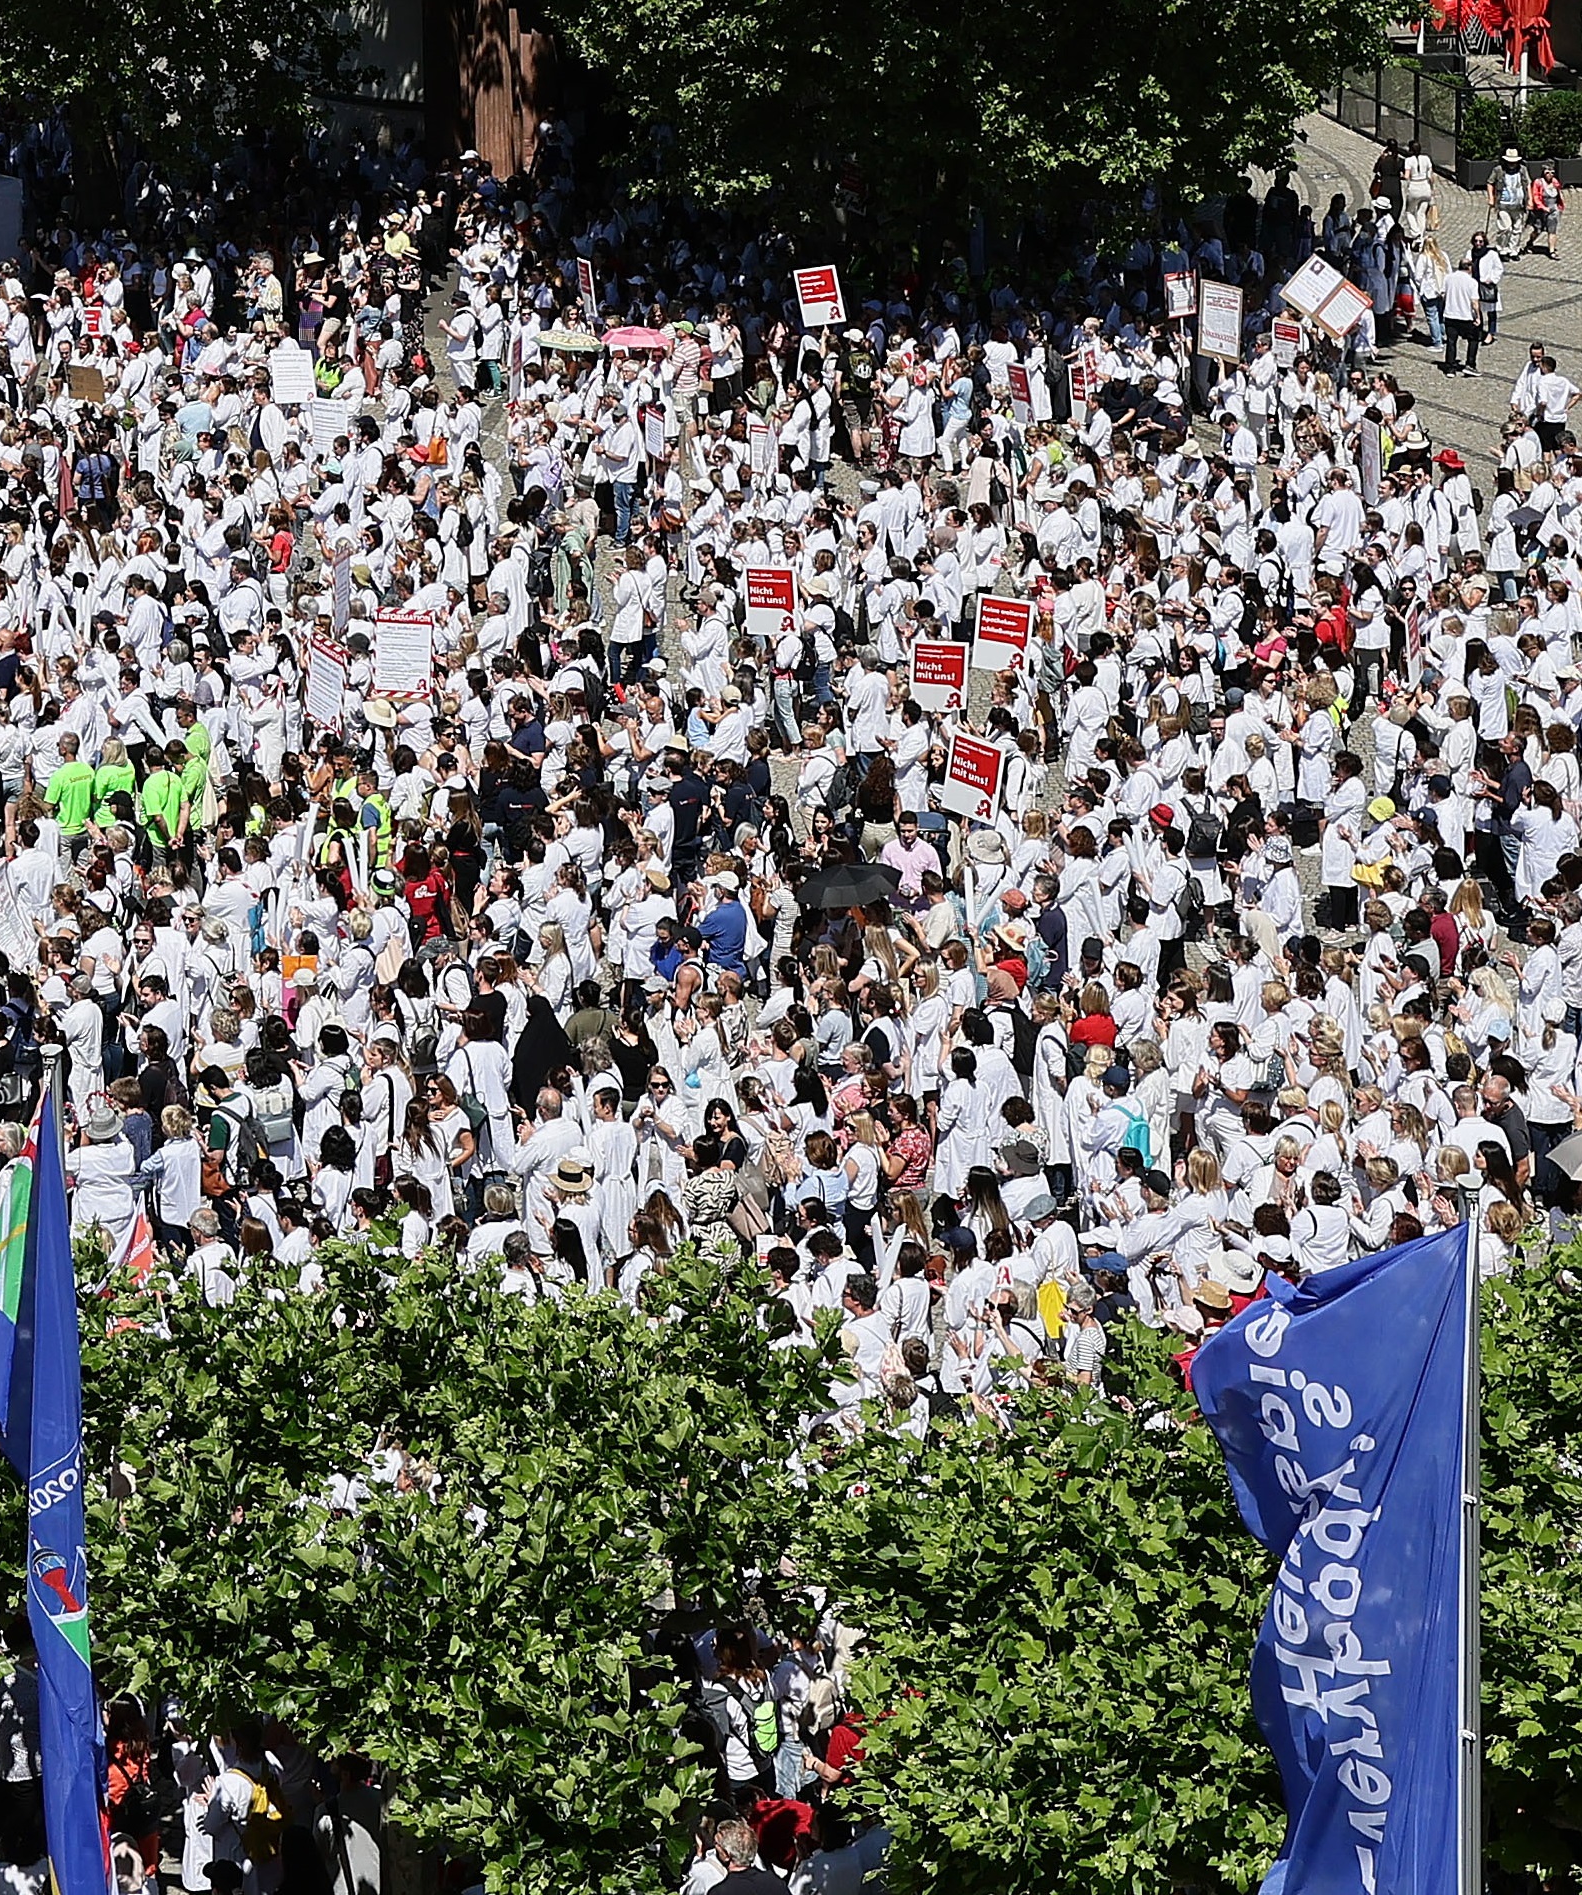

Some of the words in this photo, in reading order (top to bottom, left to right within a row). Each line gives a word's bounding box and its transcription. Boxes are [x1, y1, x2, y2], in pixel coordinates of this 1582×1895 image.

[749, 586, 773, 595] Nicht
[378, 612, 431, 623] INFORMATION
[917, 662, 942, 670] Nicht
[916, 671, 933, 679] mit
[953, 756, 974, 769] Nicht
[952, 766, 966, 778] mit
[967, 774, 985, 784] uns!
